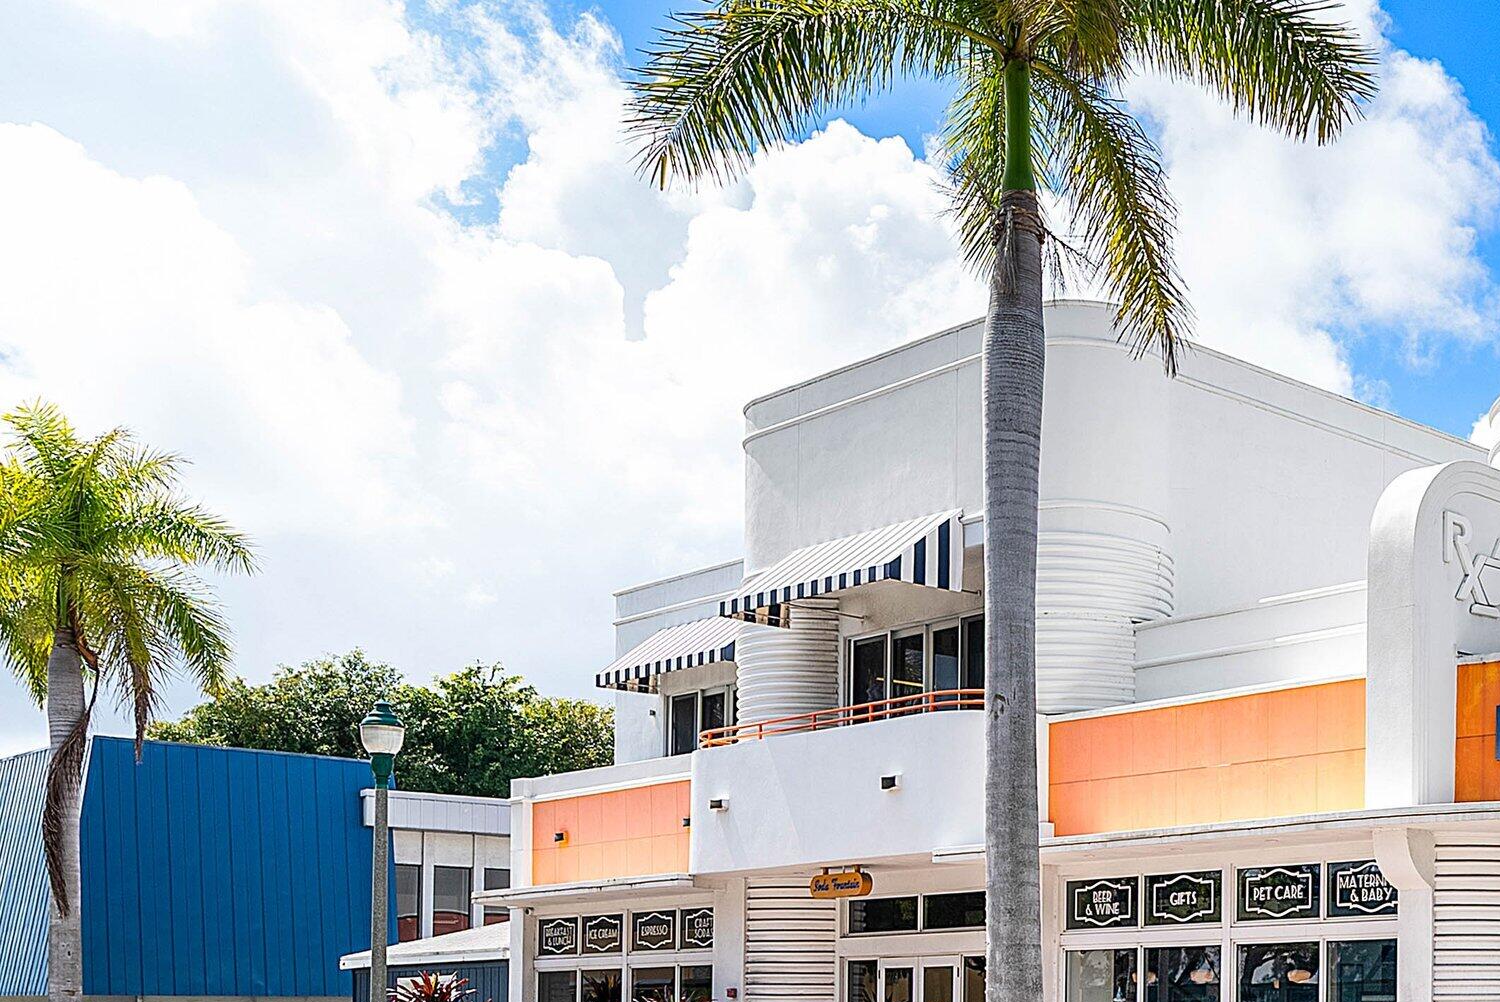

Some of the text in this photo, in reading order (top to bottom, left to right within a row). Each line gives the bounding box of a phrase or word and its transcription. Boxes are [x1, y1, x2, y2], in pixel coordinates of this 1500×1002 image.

[832, 878, 860, 890] Fountain
[1092, 890, 1112, 903] BEER
[1169, 891, 1197, 906] GIFTS
[1253, 884, 1304, 901] PET CARE
[1350, 886, 1393, 902] & BABY
[1085, 902, 1120, 916] & WINE
[545, 926, 573, 937] BREAKFAST
[589, 928, 618, 940] ICE CREAM
[641, 924, 669, 936] ESPRESSO
[547, 936, 572, 946] & LUNCH
